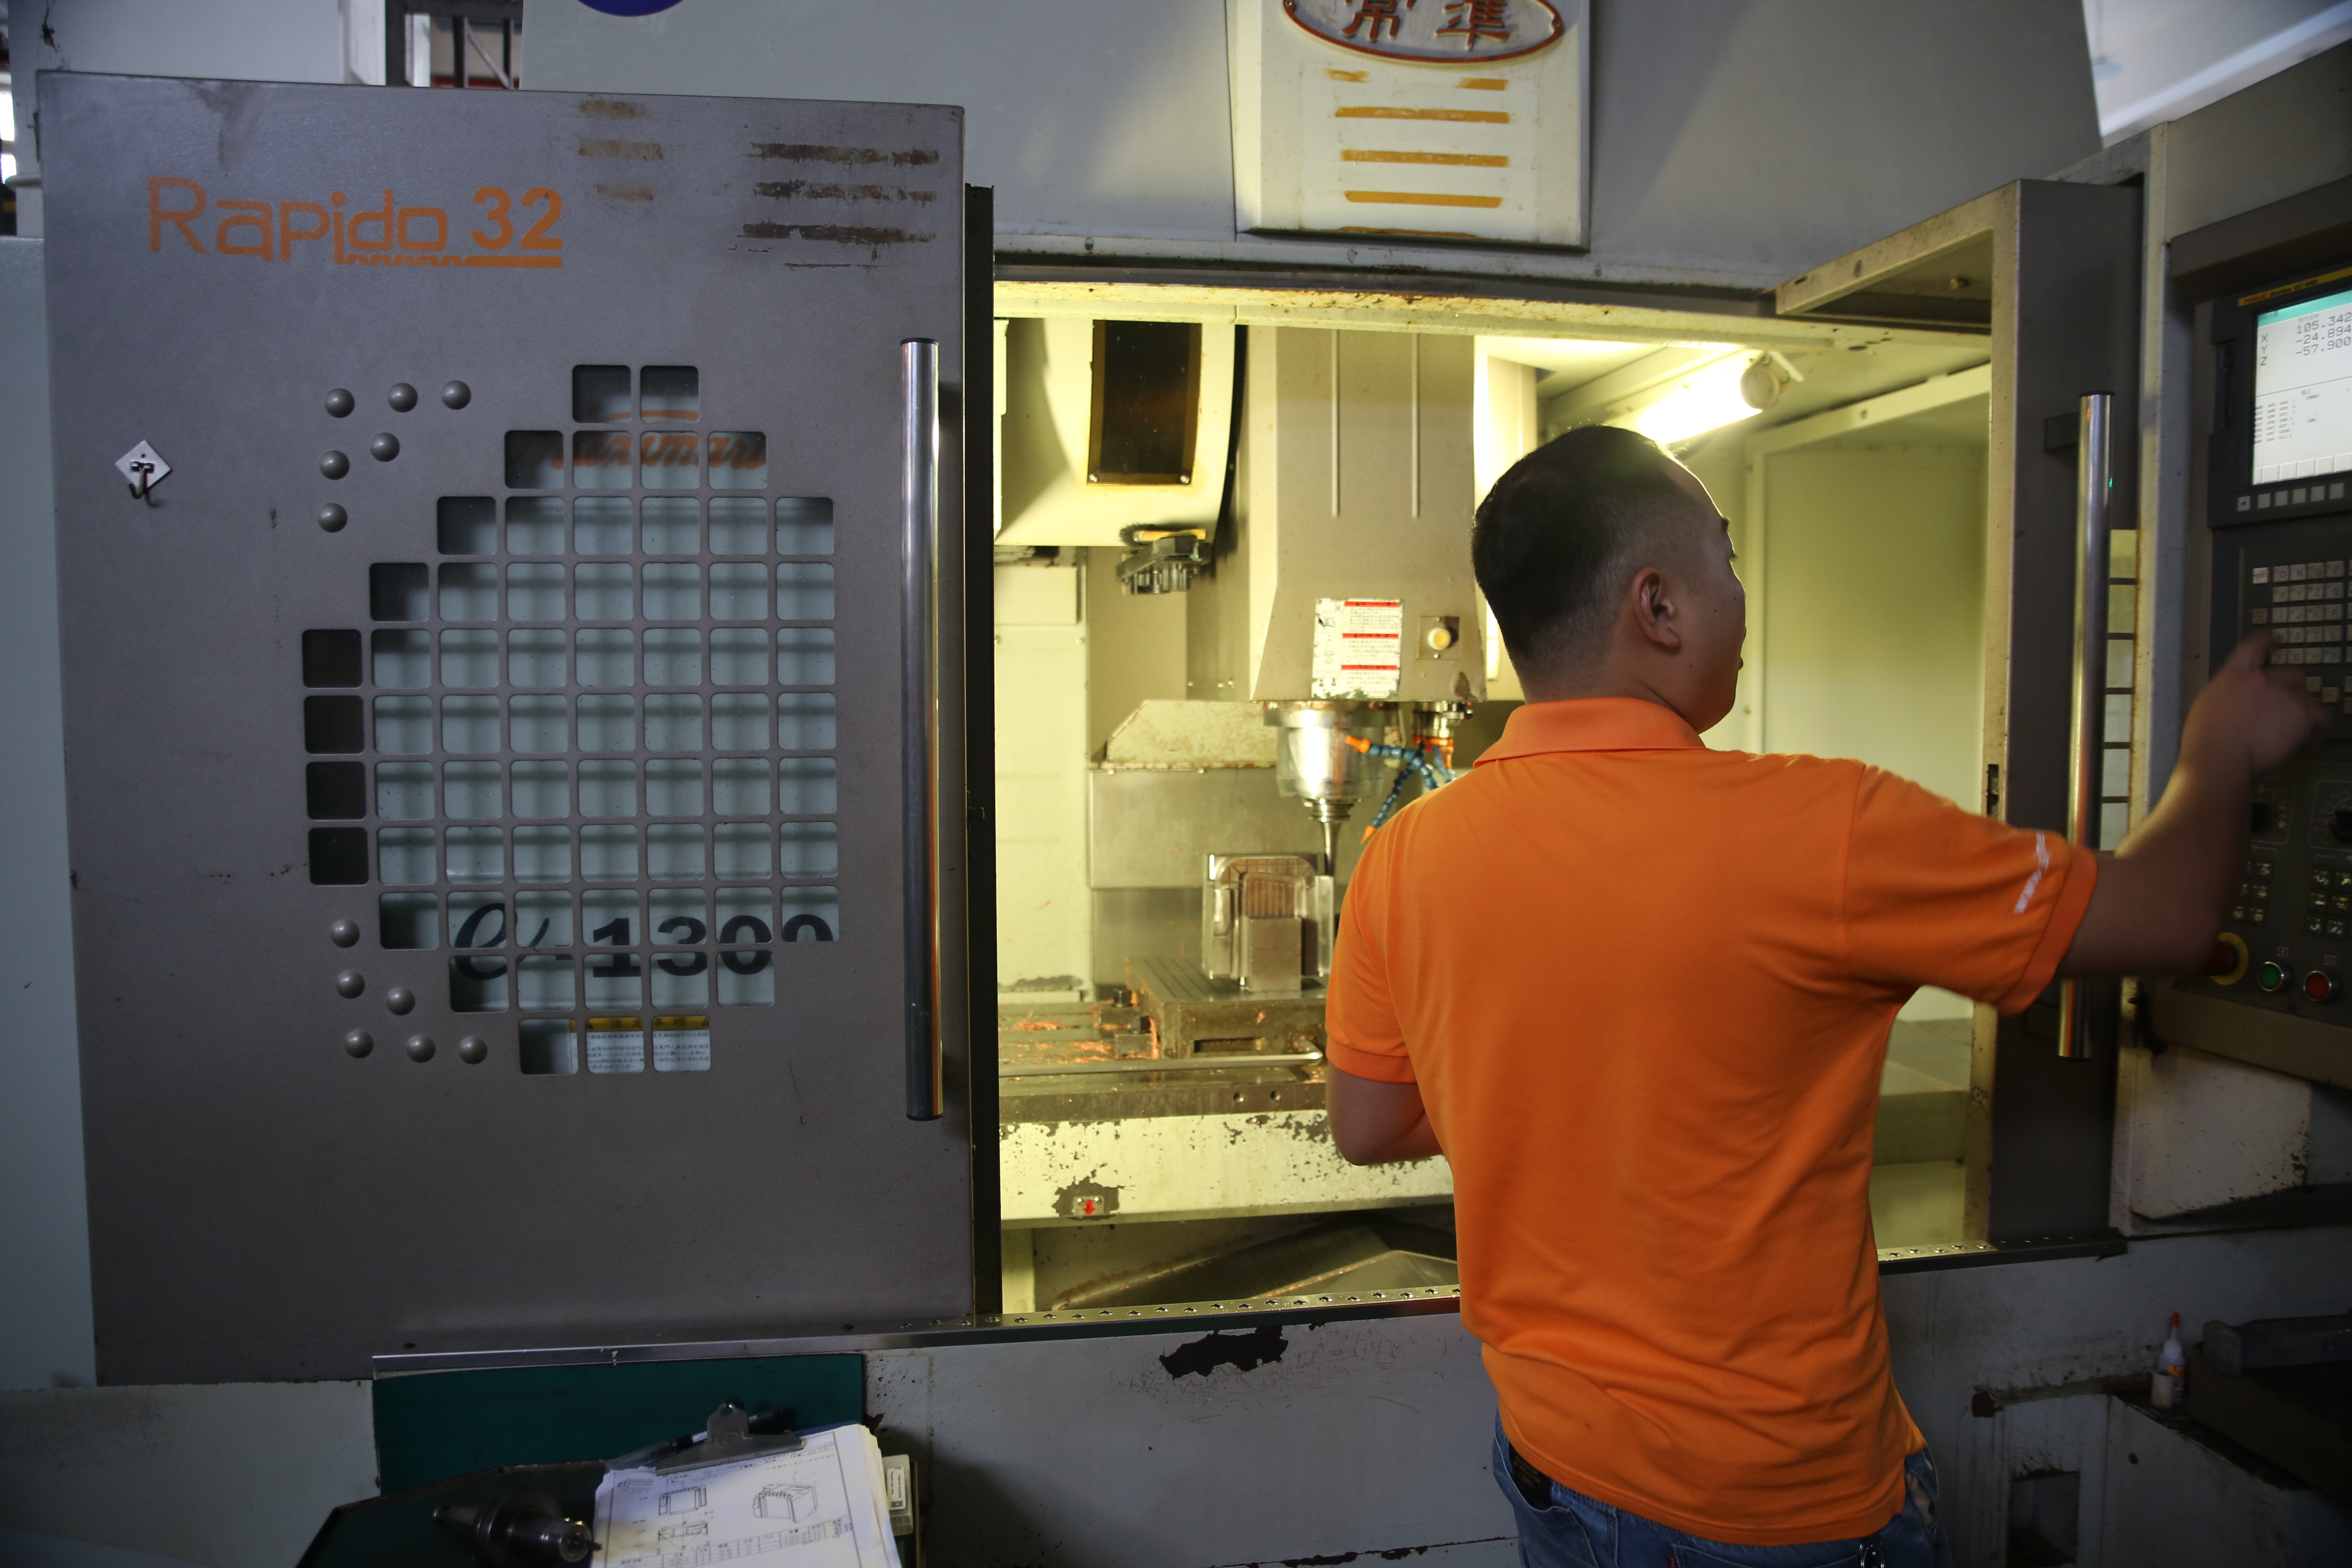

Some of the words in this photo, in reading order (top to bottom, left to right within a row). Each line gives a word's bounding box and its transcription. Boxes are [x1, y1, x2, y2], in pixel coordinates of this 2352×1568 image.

[149, 176, 448, 265] Rapido
[472, 186, 563, 251] 32
[2261, 334, 2268, 343] X
[2296, 312, 2352, 334] 105.342
[2261, 345, 2268, 354] Y
[2296, 325, 2351, 345] -24.894
[2261, 356, 2267, 366] Z
[2295, 336, 2351, 356] -57.900
